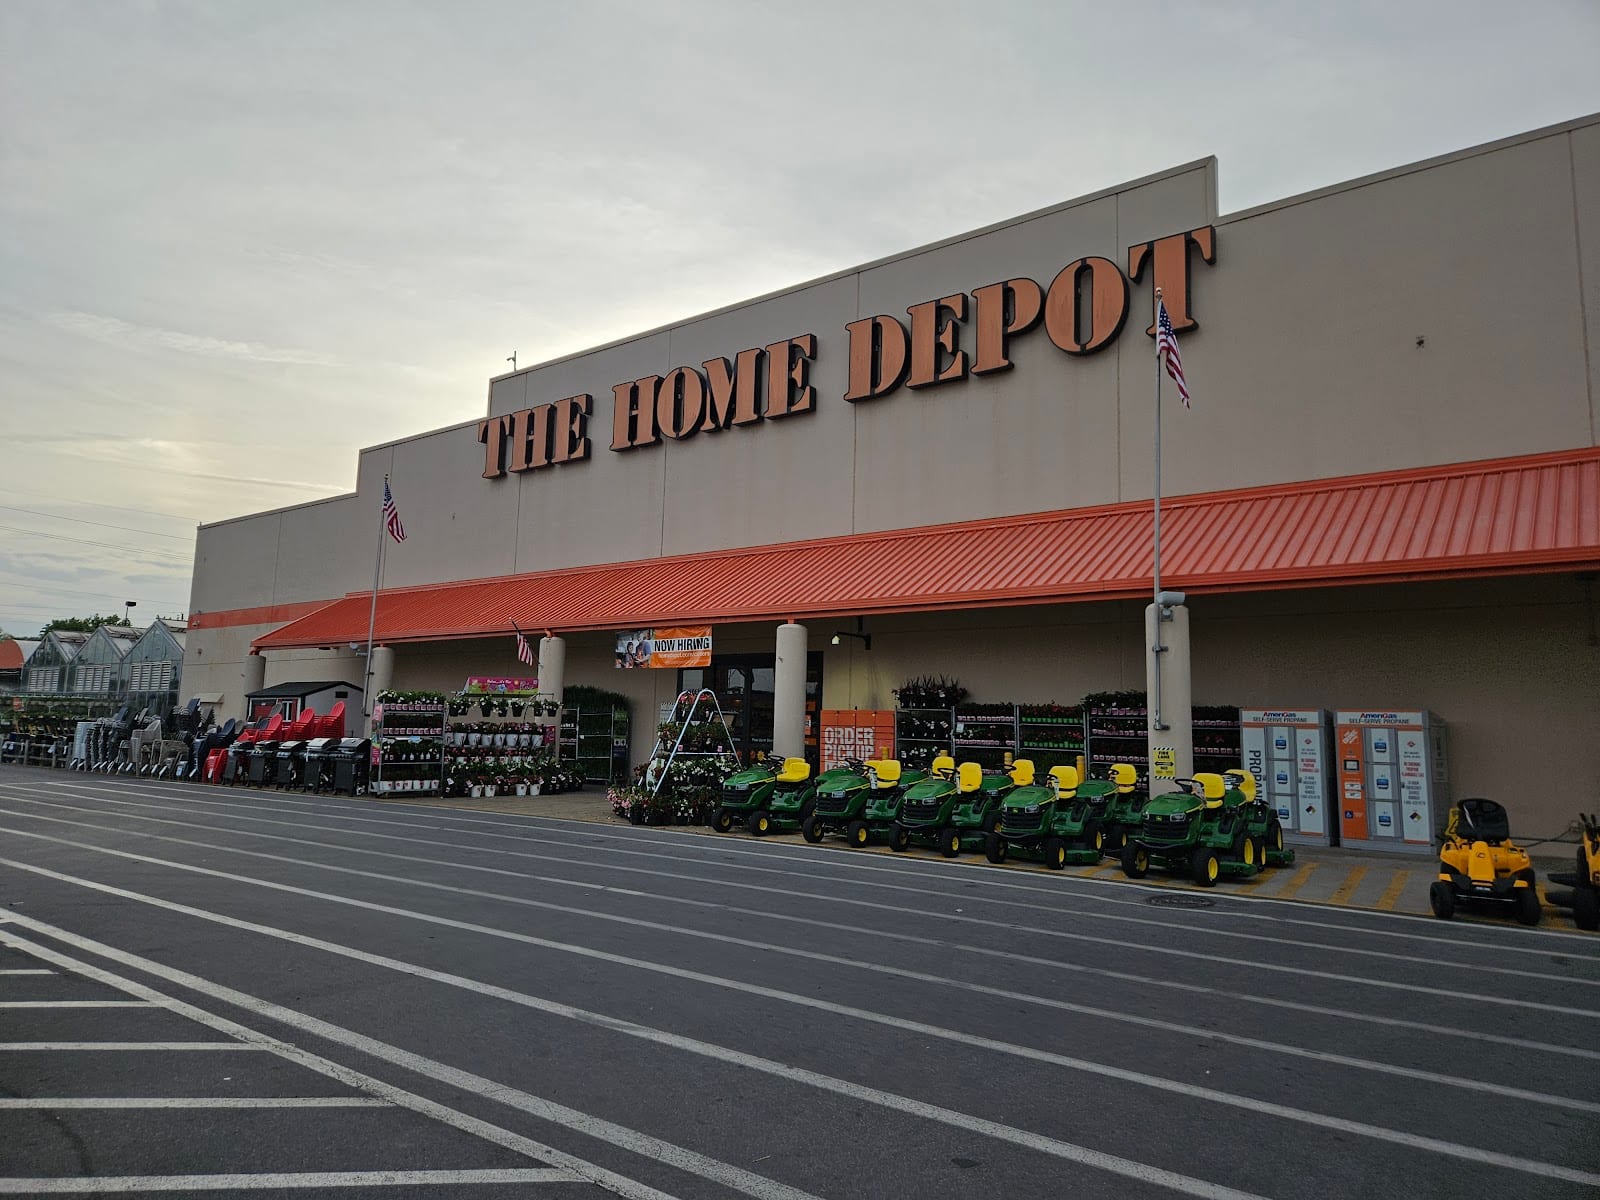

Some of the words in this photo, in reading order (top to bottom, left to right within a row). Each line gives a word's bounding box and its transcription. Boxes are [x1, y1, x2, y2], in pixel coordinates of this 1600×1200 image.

[478, 393, 593, 479] THE
[609, 333, 817, 452] HOME
[843, 225, 1216, 403] DEPOT
[654, 639, 675, 652] NOW
[677, 637, 710, 651] HIRING
[824, 727, 875, 745] ORDER
[824, 745, 875, 761] PICKUP
